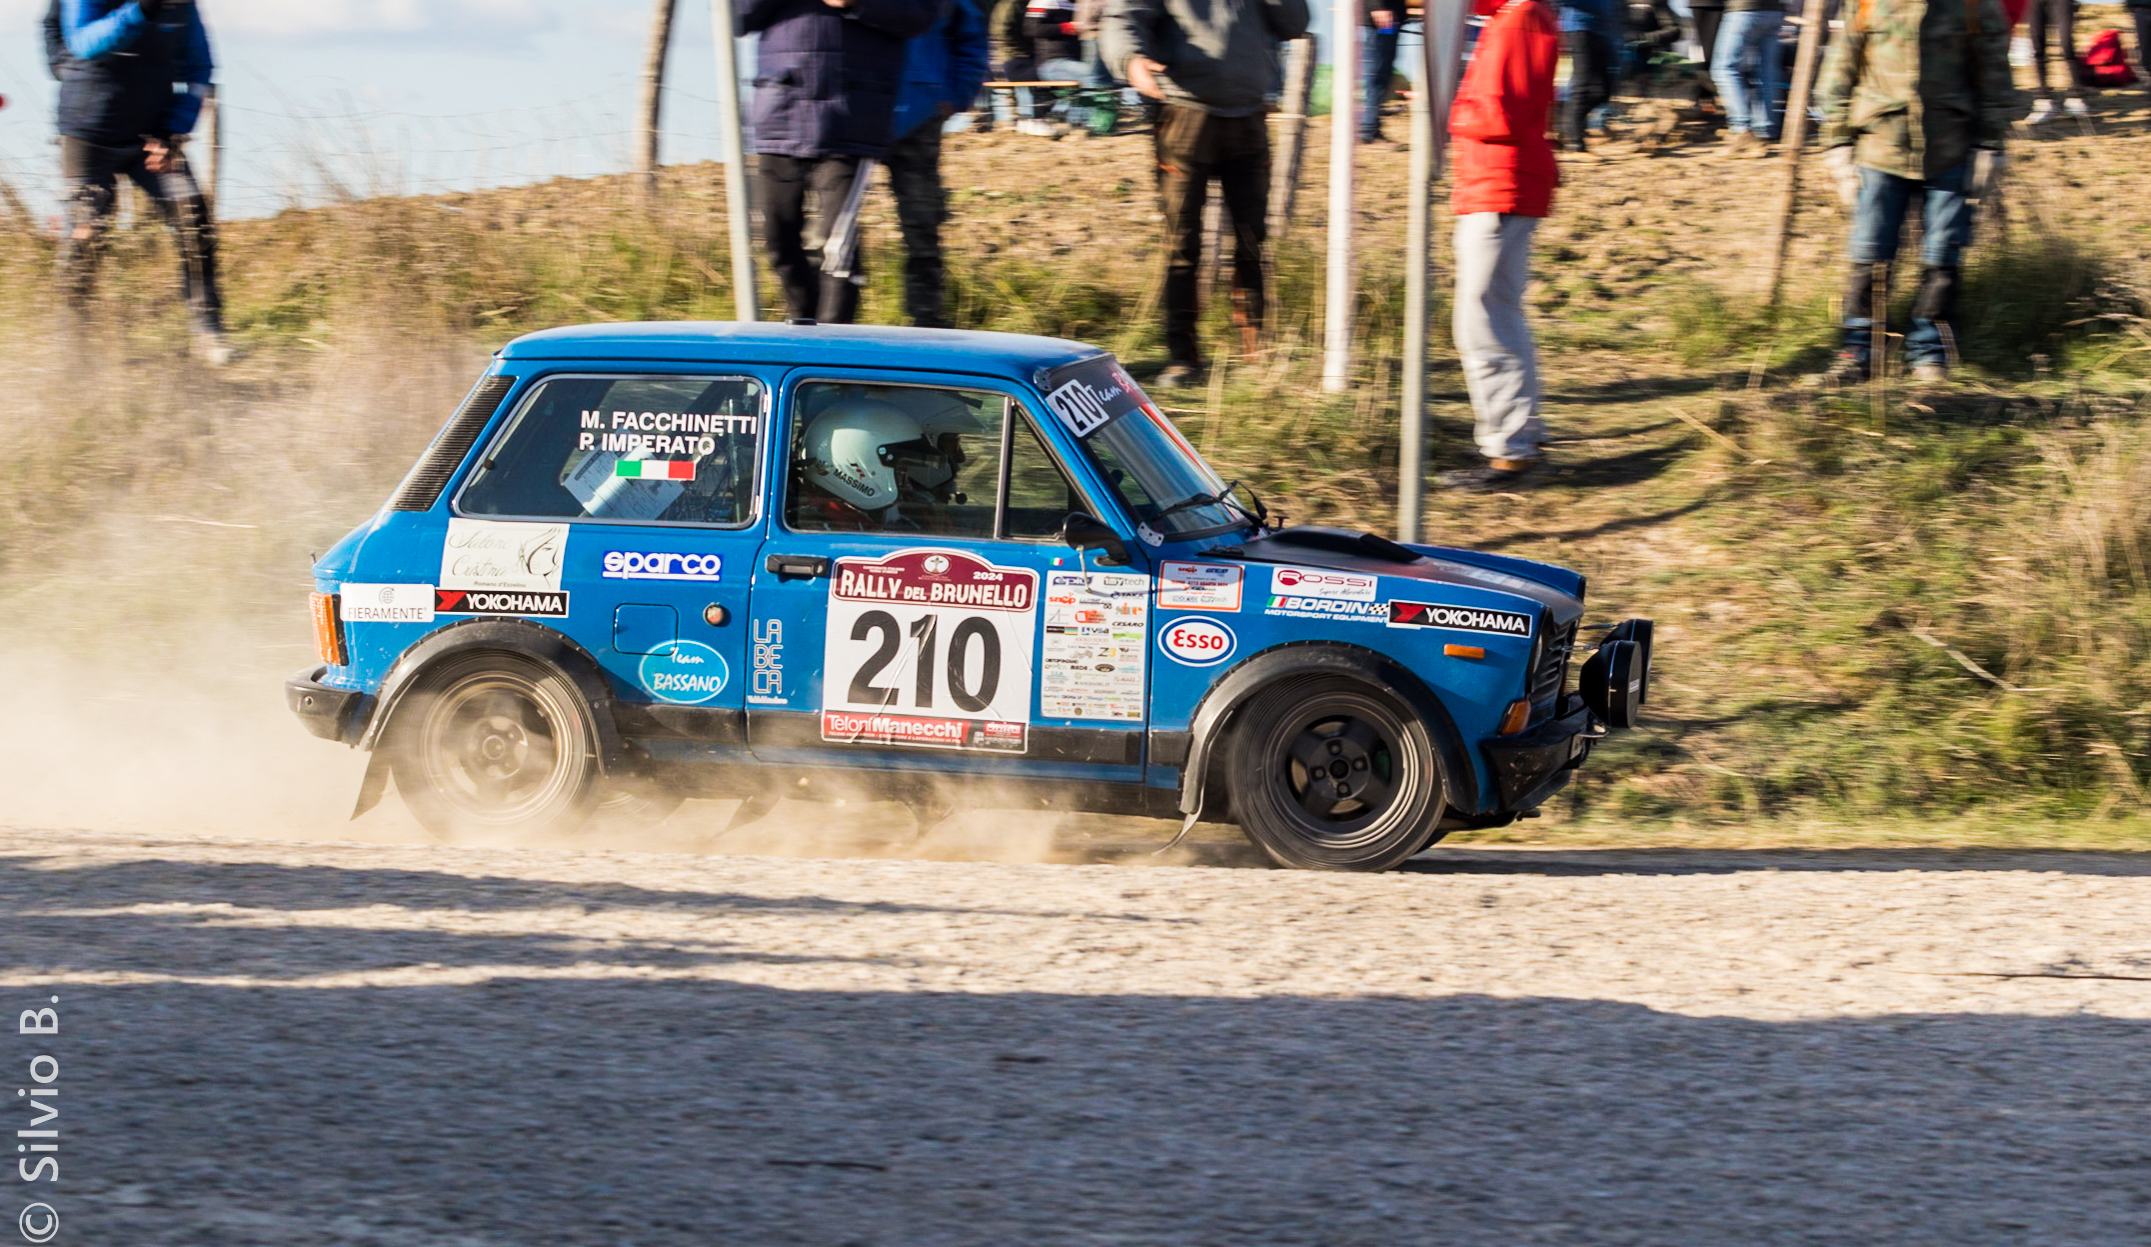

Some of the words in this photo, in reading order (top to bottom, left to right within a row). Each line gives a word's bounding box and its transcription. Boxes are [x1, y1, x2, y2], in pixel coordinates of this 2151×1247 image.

[1085, 384, 1122, 406] Team
[1055, 384, 1103, 432] 210
[580, 410, 605, 429] M.
[612, 411, 758, 435] FACCHINETTI
[579, 432, 594, 450] P.
[601, 433, 716, 456] IMPERATO
[833, 468, 876, 497] MASSIMO
[603, 551, 722, 580] sparco
[972, 571, 1004, 582] 2024
[840, 569, 902, 599] RALLY
[904, 586, 927, 601] DEL
[930, 583, 1028, 608] BRUNELLO
[1278, 569, 1373, 588] ROSSI
[466, 593, 564, 612] YOKOHAMA
[1285, 597, 1370, 615] BORDIN
[1264, 609, 1333, 620] MOTORSPORT
[1333, 613, 1388, 624] EQUIPMENT
[1425, 607, 1526, 633] YOKOHAMA
[1173, 628, 1224, 651] Esso
[669, 647, 705, 665] Team
[847, 609, 1001, 713] 210
[652, 672, 721, 693] BASSANO
